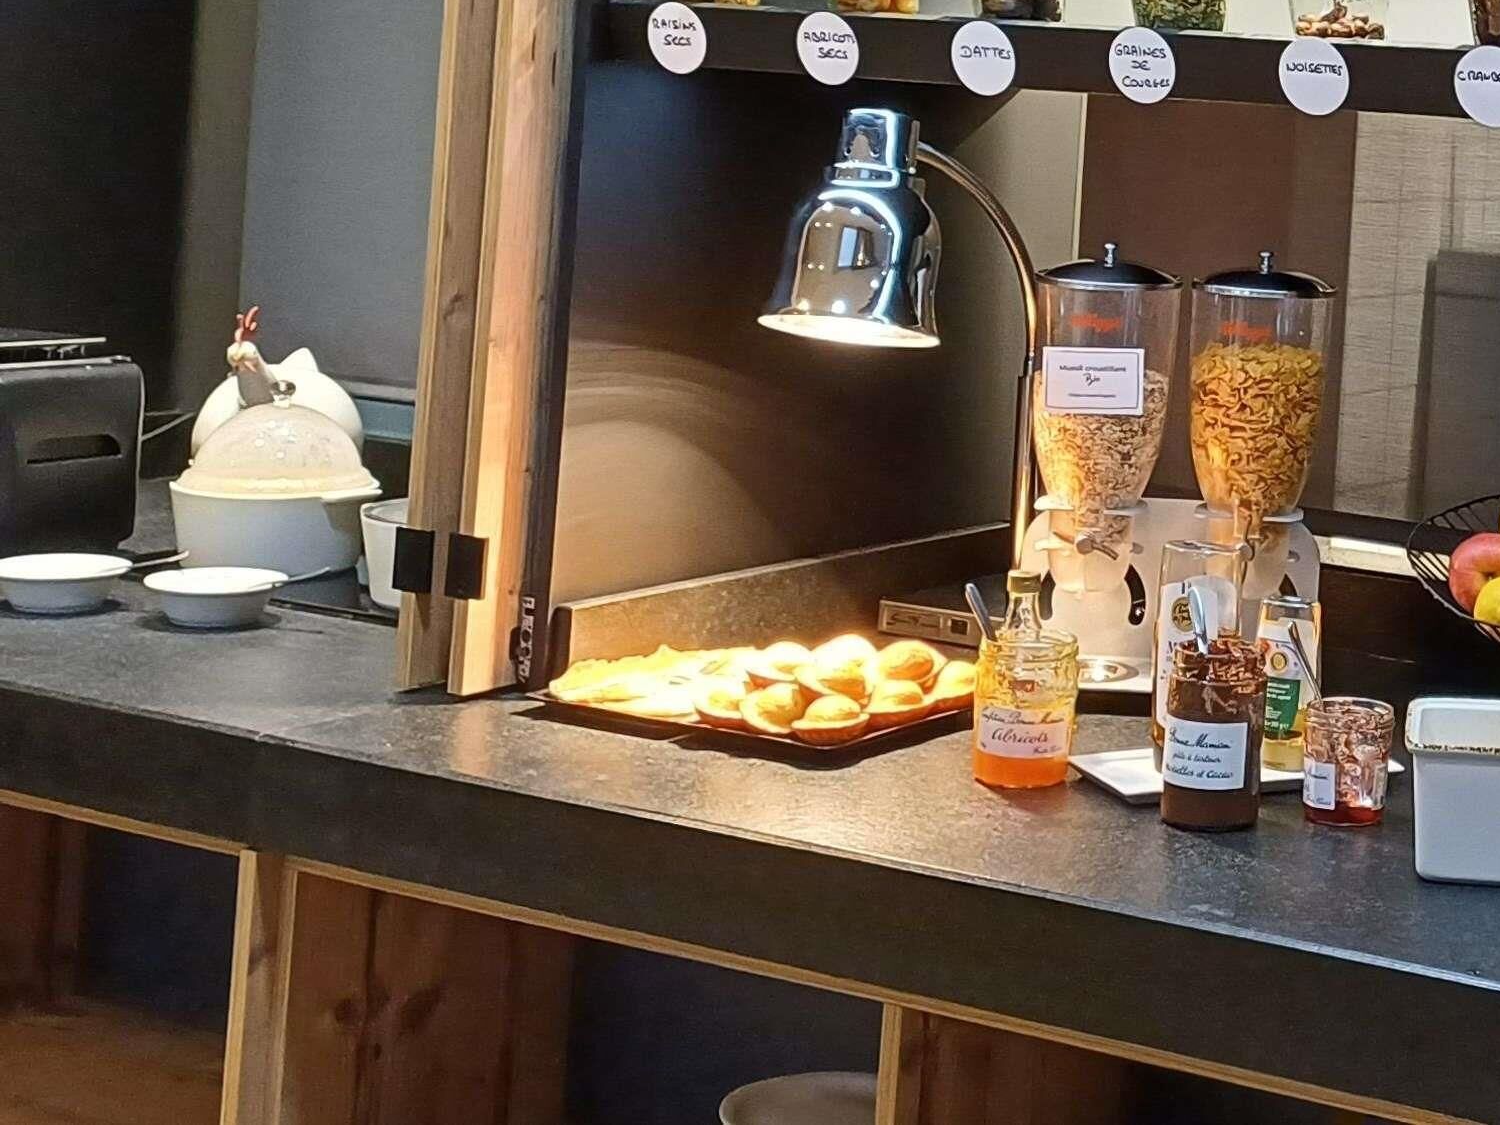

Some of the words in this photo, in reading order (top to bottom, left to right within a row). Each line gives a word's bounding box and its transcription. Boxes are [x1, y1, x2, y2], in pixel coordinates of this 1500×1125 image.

[817, 47, 849, 60] SECS
[959, 45, 1012, 60] DATTES
[1114, 43, 1167, 59] GRAINES
[1286, 62, 1343, 76] NOISETTES
